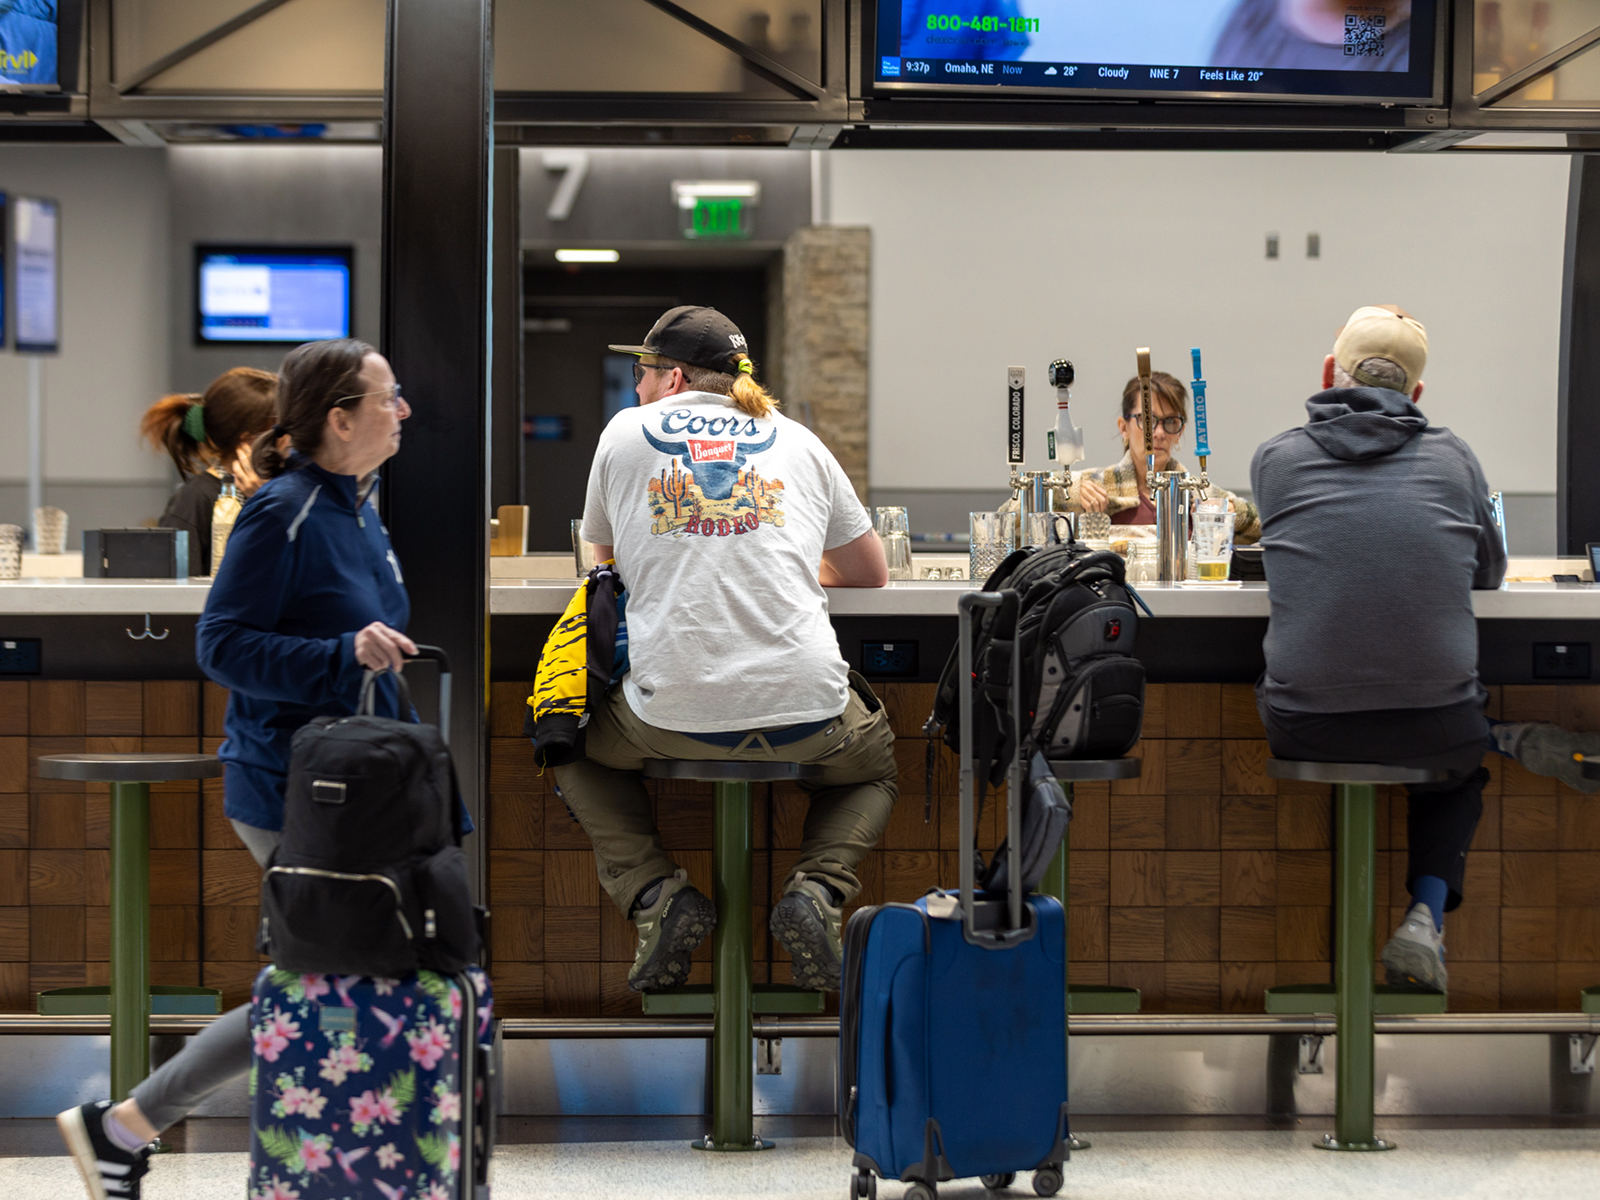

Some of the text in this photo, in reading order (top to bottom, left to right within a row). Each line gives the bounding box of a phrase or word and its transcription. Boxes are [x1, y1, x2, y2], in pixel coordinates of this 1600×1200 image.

[926, 14, 1040, 33] 800-481-1811
[906, 61, 1264, 82] 9:37p Omaha, NE Now 28° Cloudy NNE 7 Feels Like 20°
[541, 149, 588, 219] 7
[660, 408, 760, 437] Coors
[1012, 391, 1021, 460] FRISCO, COLORADO
[1143, 392, 1152, 443] ELEVATION
[1195, 395, 1207, 444] OUTLAW
[694, 442, 733, 460] Banquet
[684, 512, 760, 537] RODEO
